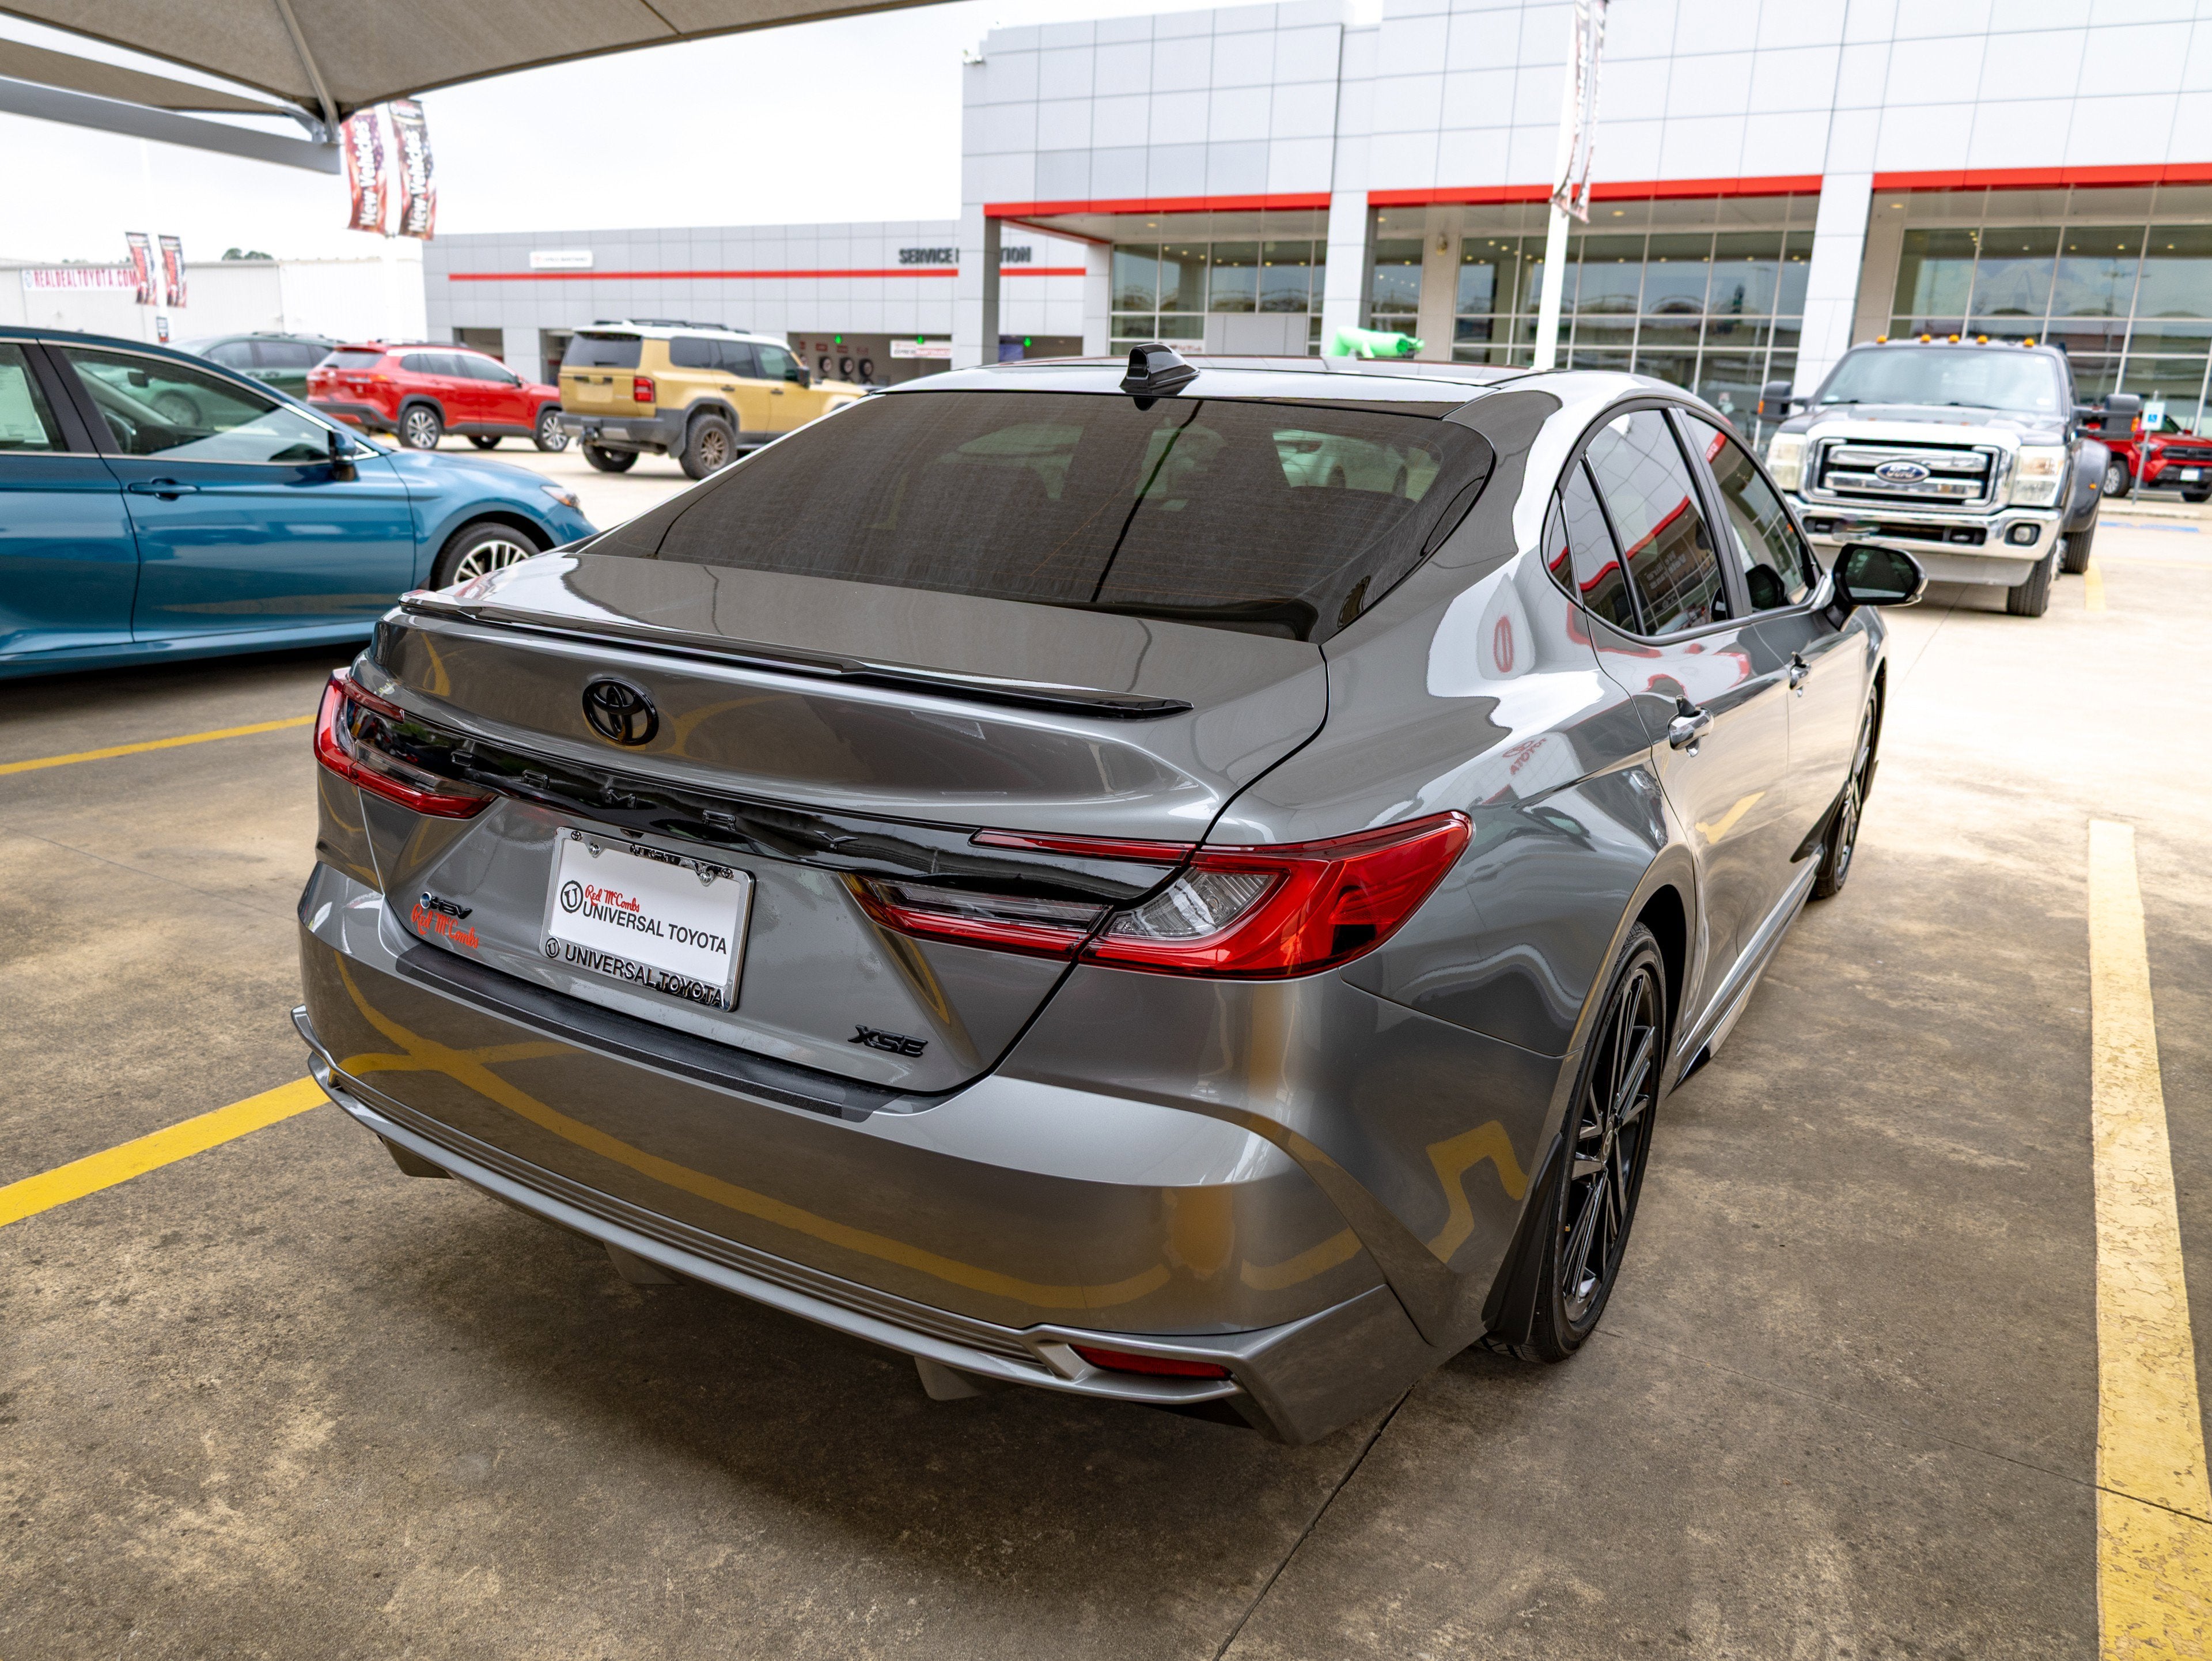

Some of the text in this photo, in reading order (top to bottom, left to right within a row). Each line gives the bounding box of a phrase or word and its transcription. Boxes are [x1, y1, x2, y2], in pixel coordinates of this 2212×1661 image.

[354, 120, 377, 226] New Vehicles
[404, 130, 427, 195] Vehicles
[408, 196, 427, 232] New
[899, 248, 953, 264] SERVICE
[1886, 466, 1917, 478] Ford
[585, 884, 640, 913] Red McCombs
[411, 903, 479, 949] Red McCombs
[583, 901, 727, 955] UNIVERSAL TOYOTA
[565, 943, 725, 1008] UNIVERSAL TOYOTA
[847, 1024, 929, 1058] XSE
